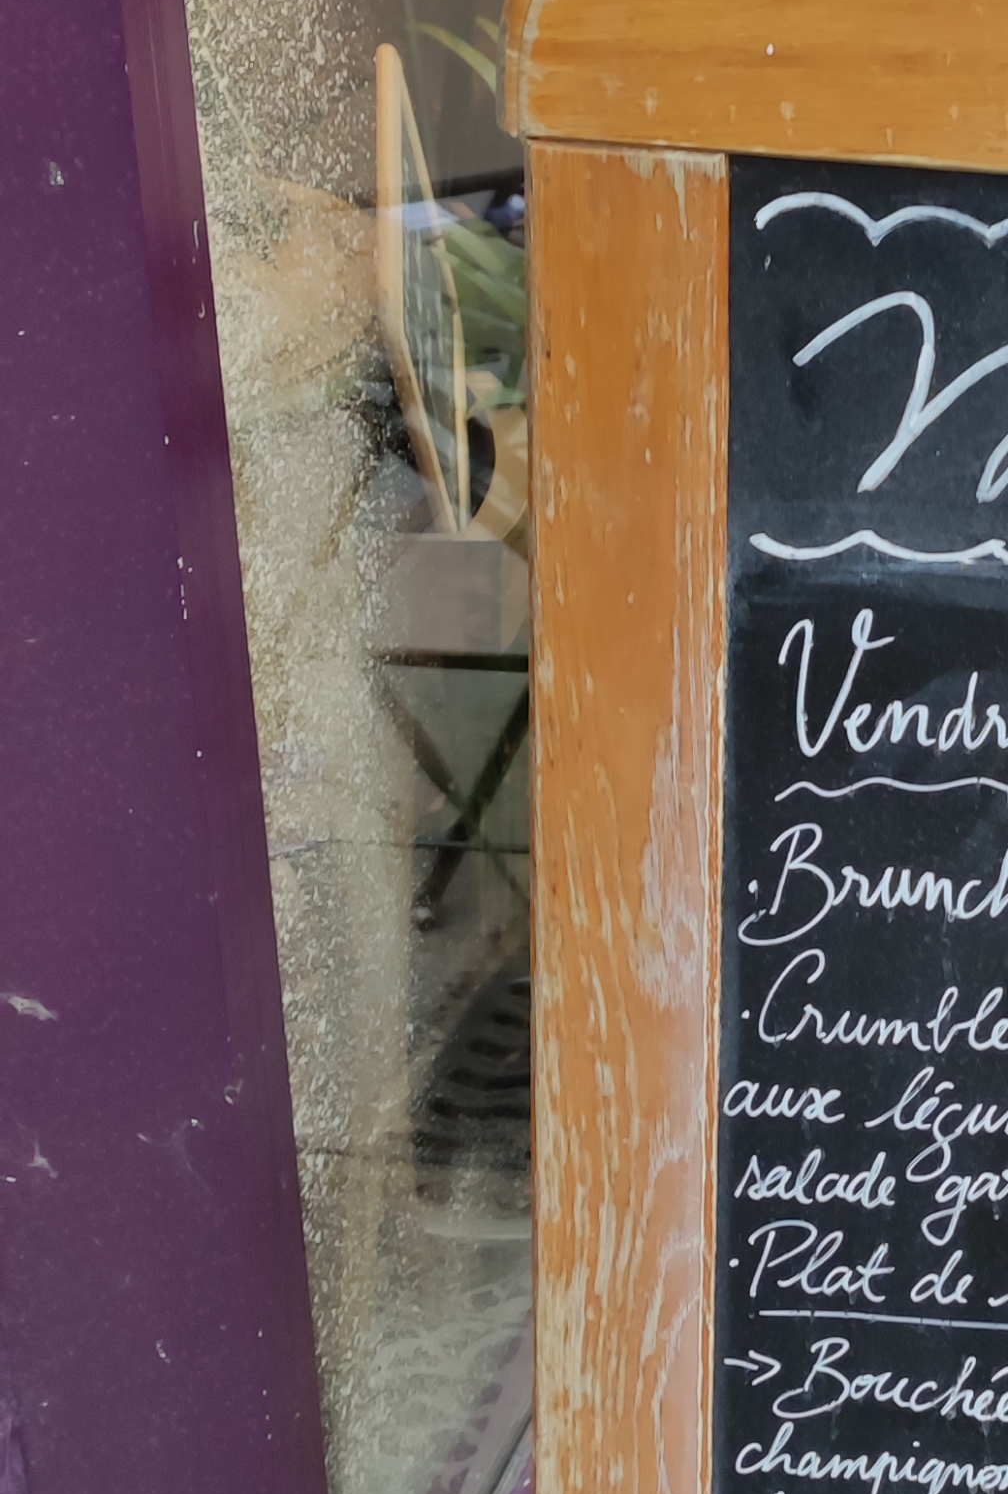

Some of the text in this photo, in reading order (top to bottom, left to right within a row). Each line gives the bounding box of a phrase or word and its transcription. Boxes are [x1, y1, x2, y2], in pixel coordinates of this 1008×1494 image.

[722, 1078, 846, 1125] aux
[733, 1148, 896, 1207] salade
[909, 1249, 974, 1306] de
